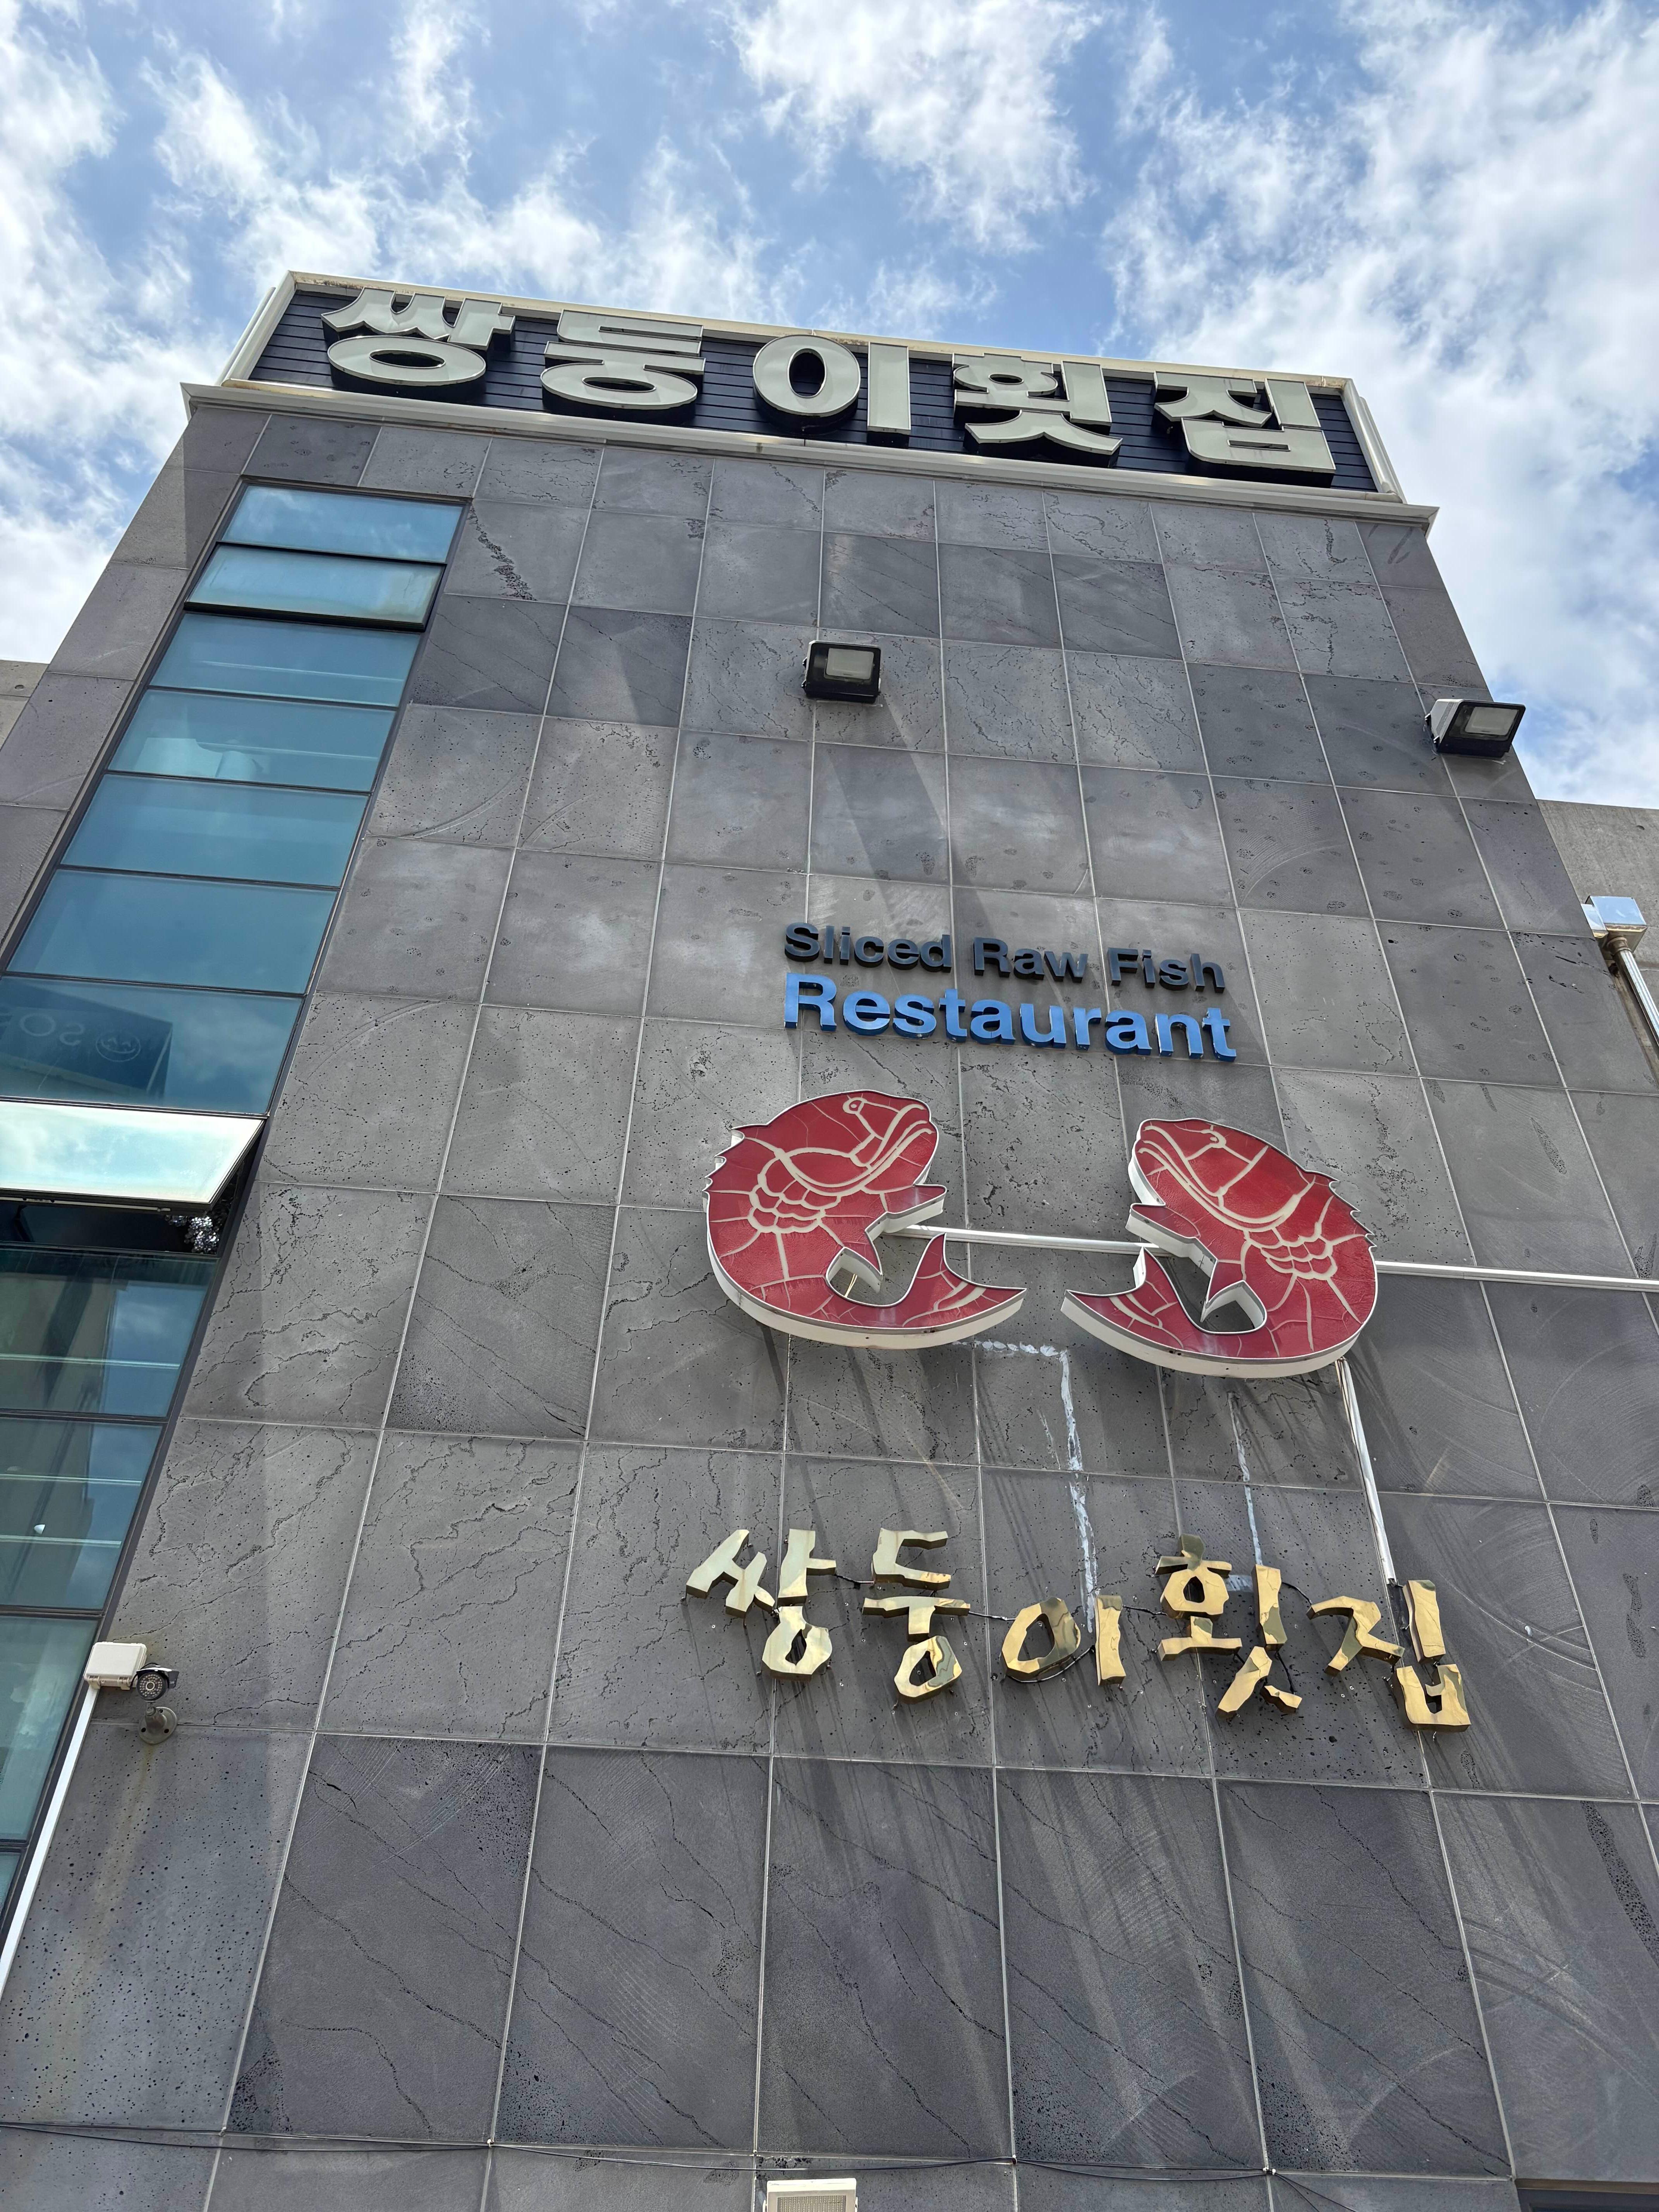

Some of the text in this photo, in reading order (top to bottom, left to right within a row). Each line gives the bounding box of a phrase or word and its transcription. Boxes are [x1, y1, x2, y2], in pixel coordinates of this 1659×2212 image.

[321, 287, 1336, 473] 쌍둥이횟집
[783, 972, 1237, 1062] Restaurant
[784, 922, 1225, 993] Sliced Raw Fish
[685, 1528, 1472, 1733] 쌍둥이횟집
